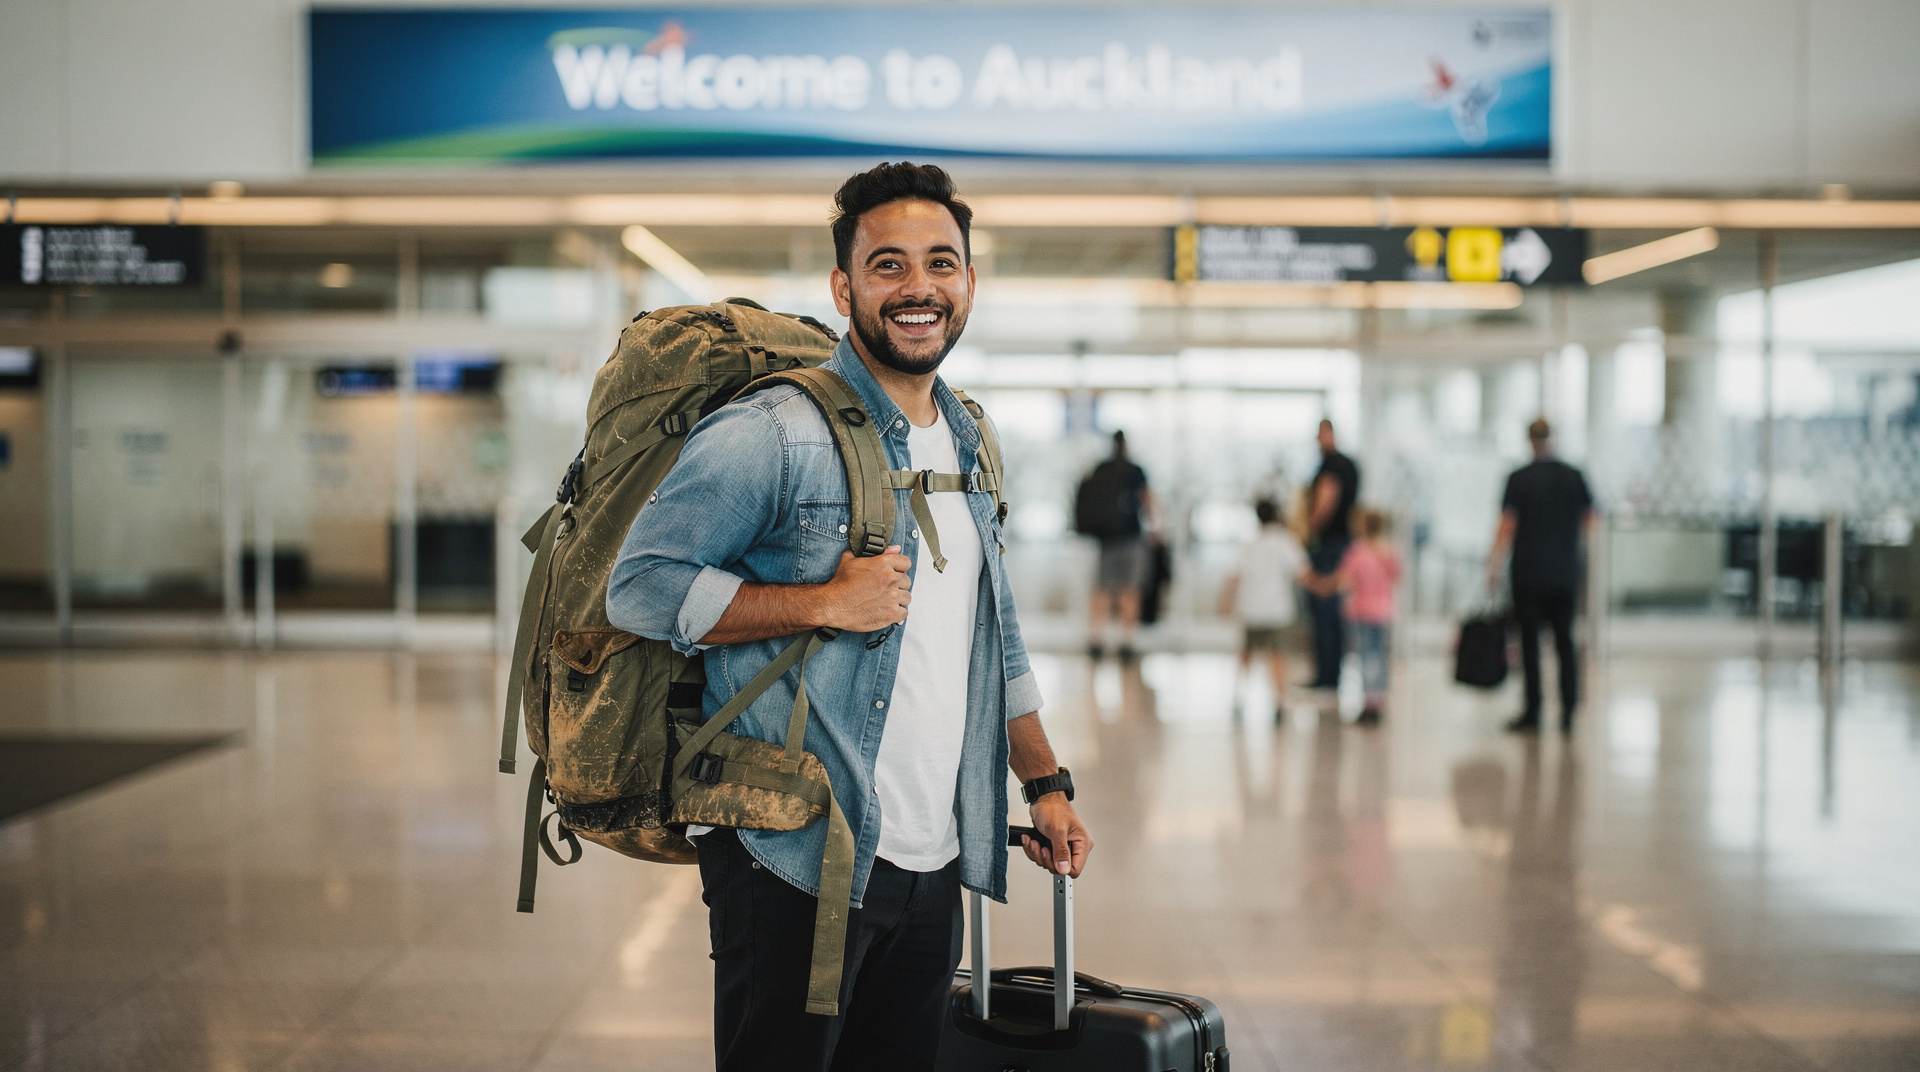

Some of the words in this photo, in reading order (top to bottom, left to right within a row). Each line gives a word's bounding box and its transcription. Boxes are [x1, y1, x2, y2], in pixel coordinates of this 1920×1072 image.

[554, 43, 871, 111] Welcome
[884, 48, 963, 110] to
[973, 41, 1303, 111] Auckland
